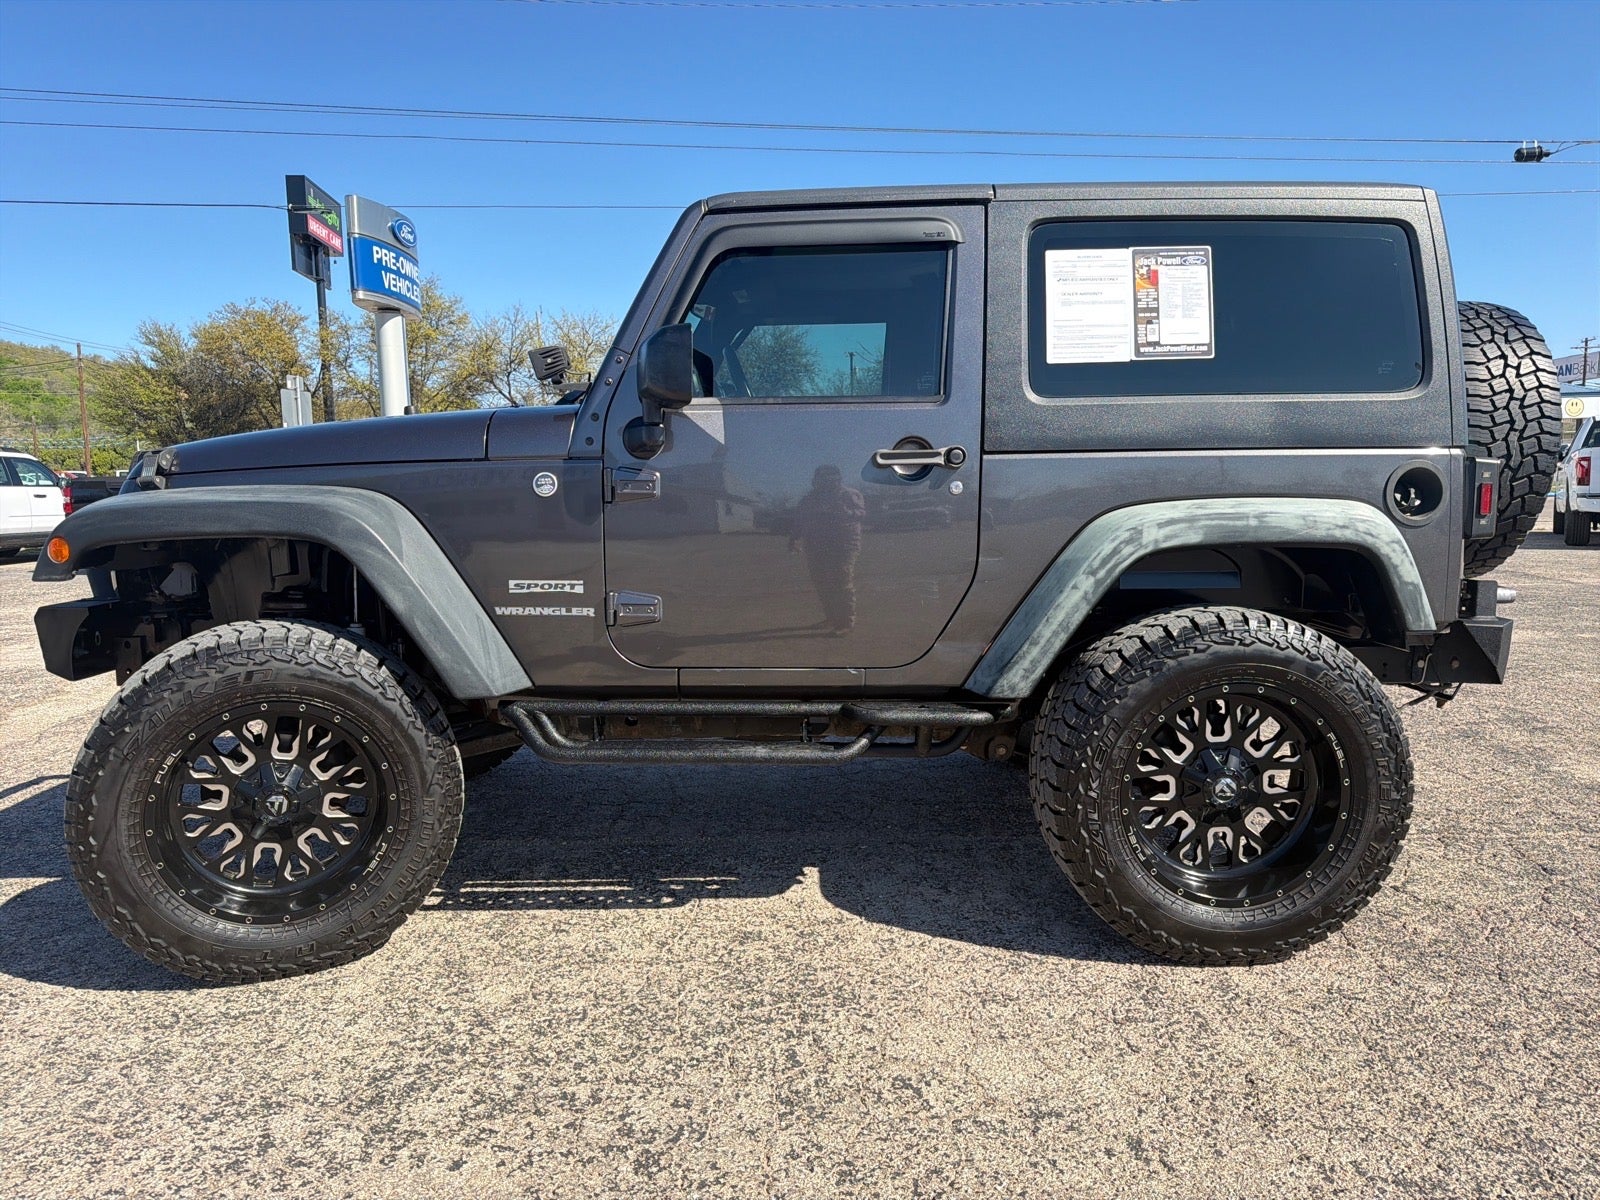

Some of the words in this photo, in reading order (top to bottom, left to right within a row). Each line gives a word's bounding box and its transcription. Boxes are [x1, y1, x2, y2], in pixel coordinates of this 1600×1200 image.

[309, 219, 329, 240] URGENT
[329, 233, 342, 250] CARE
[400, 224, 415, 243] Ford
[372, 245, 421, 284] PRE-OWNE
[1139, 256, 1157, 266] Jack
[1157, 256, 1181, 265] Powell
[1556, 361, 1596, 377] ANBank
[512, 583, 581, 591] SPORT
[494, 606, 596, 617] WRANGLER
[122, 668, 274, 762] FALKEN
[1327, 731, 1346, 769] FUEL
[154, 748, 184, 785] FUEL
[362, 842, 388, 876] FUEL
[1125, 825, 1148, 862] FUEL
